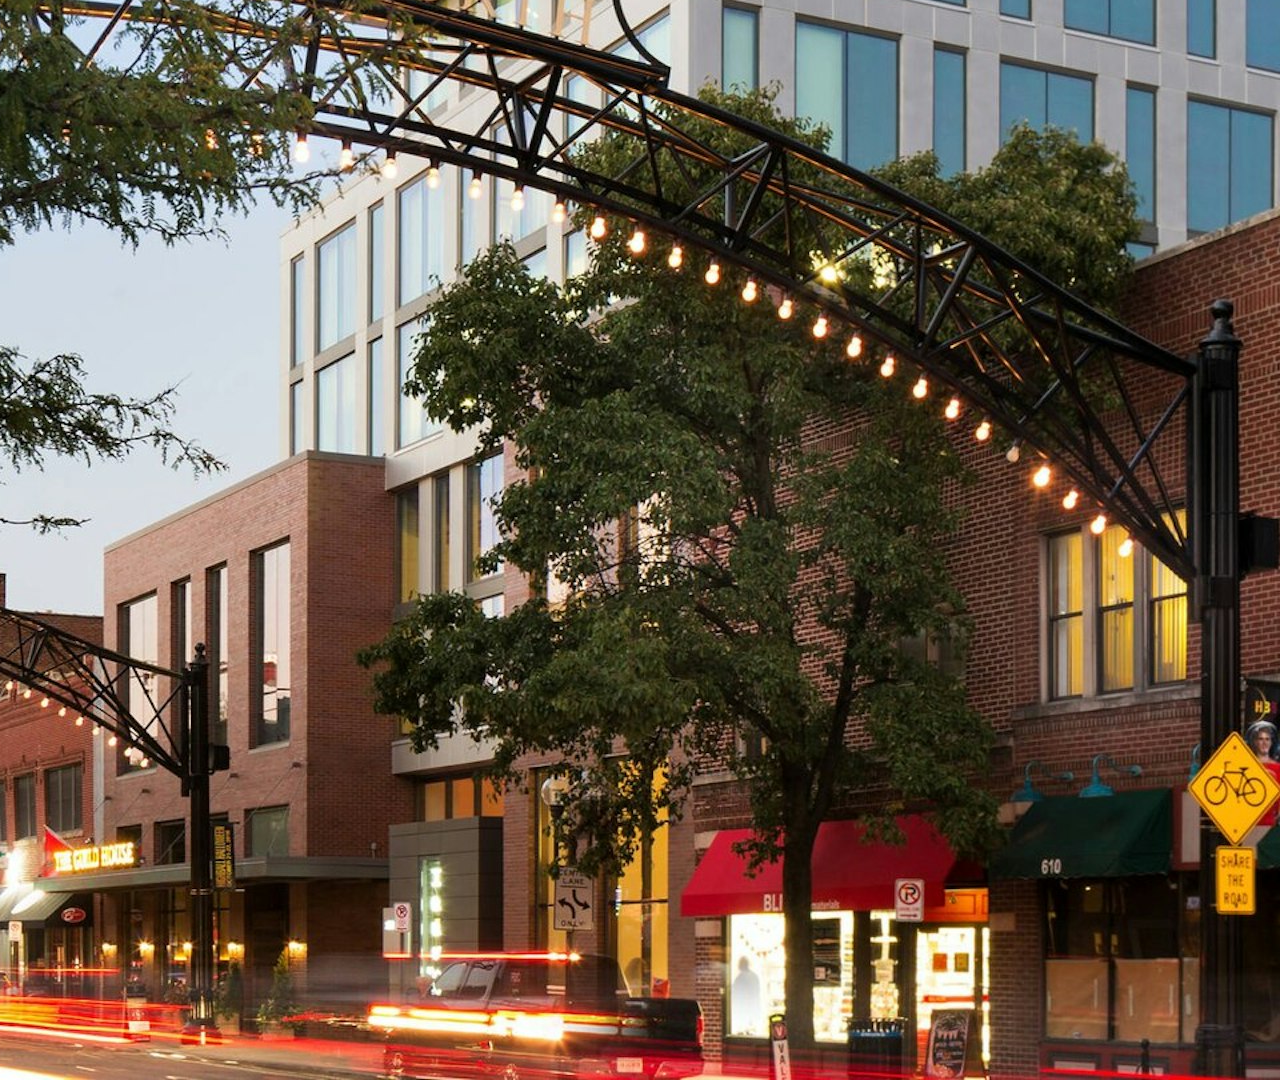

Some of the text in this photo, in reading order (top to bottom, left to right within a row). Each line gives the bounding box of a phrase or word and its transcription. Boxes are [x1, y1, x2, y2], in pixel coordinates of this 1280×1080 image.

[54, 841, 134, 872] THE GUILD HOUSE
[1221, 854, 1251, 869] SHARE
[1041, 858, 1062, 875] 610
[562, 876, 585, 885] LANE
[1228, 873, 1245, 887] THE
[1223, 892, 1249, 905] ROAD
[560, 920, 585, 928] ONLY
